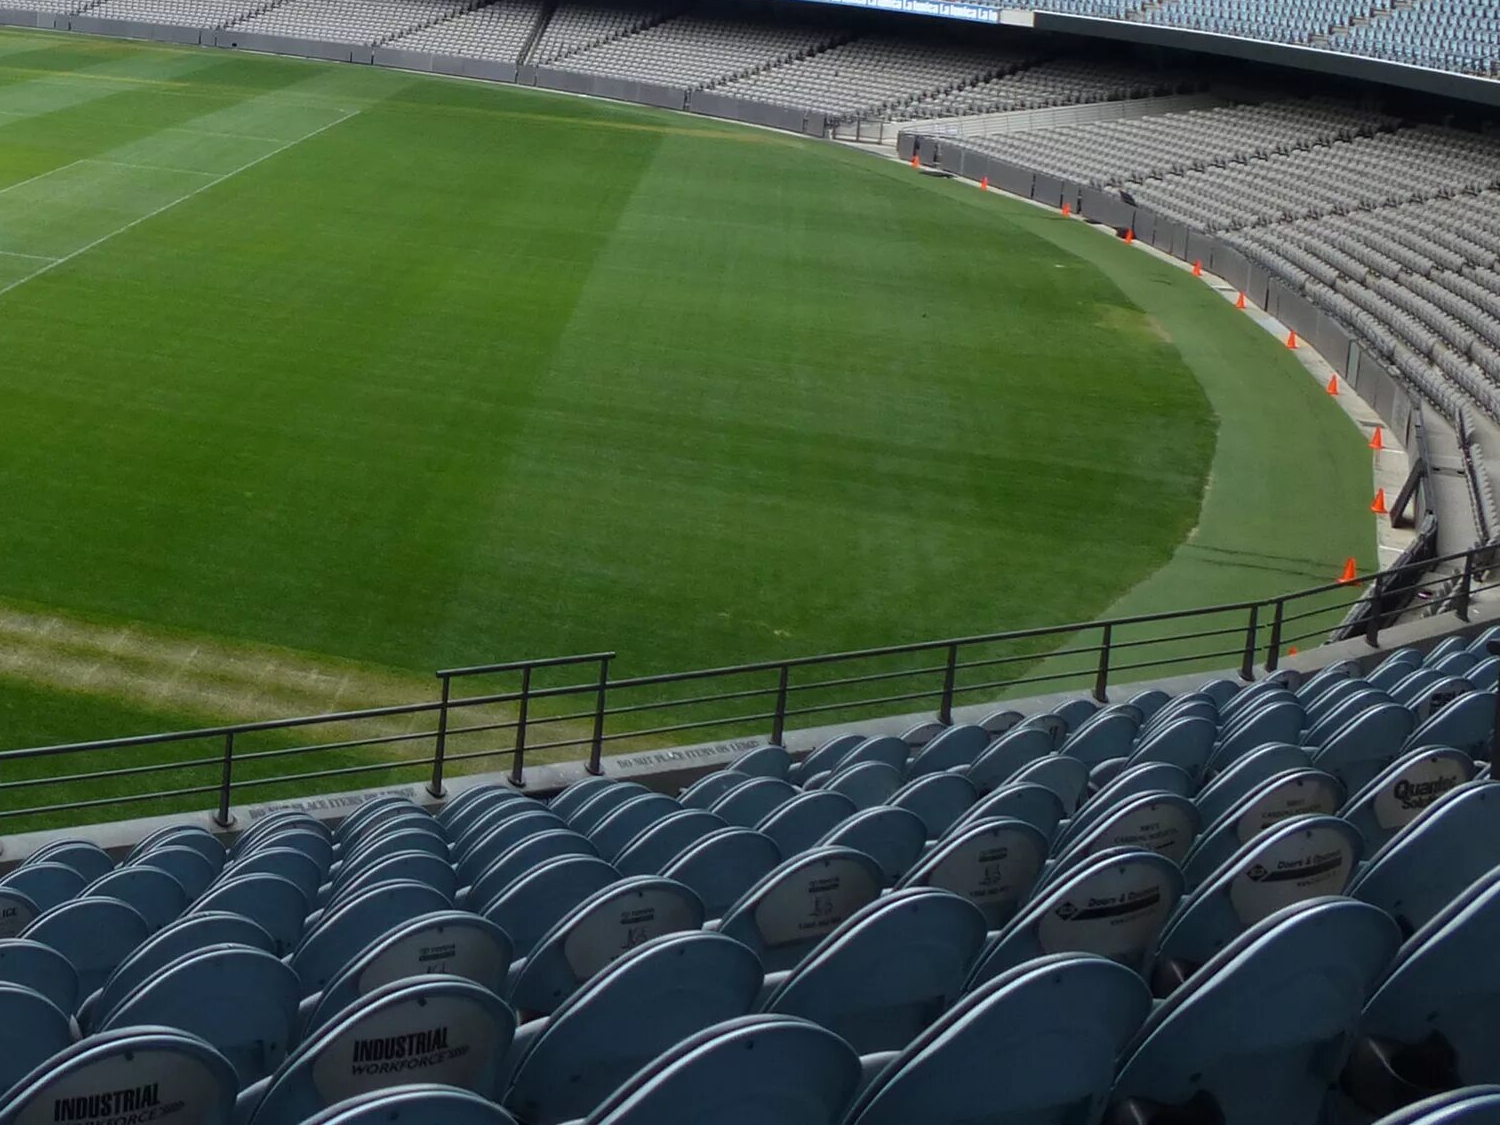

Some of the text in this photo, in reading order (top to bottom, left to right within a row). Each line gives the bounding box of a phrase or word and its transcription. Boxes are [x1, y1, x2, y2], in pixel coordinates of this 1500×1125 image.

[353, 1026, 448, 1063] INDUSTRIAL
[351, 1051, 445, 1076] WORKFORCE
[54, 1082, 160, 1122] INDUSTRIAL
